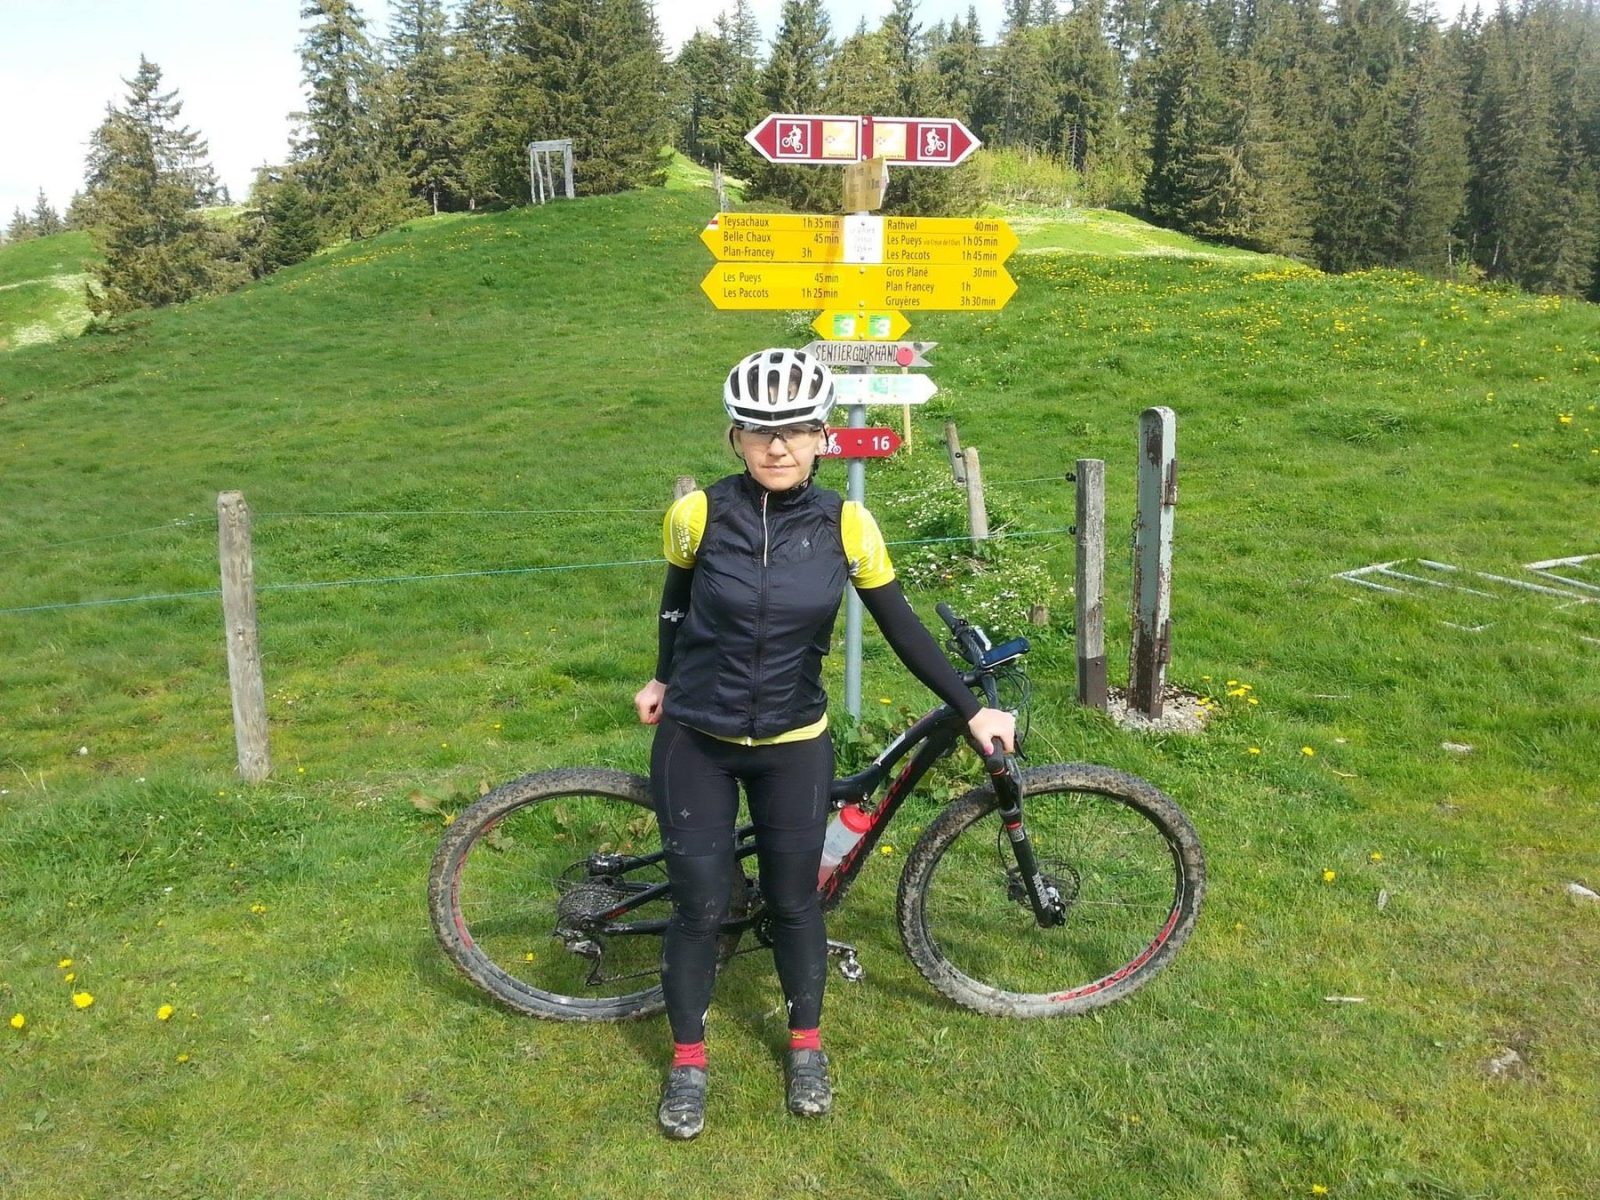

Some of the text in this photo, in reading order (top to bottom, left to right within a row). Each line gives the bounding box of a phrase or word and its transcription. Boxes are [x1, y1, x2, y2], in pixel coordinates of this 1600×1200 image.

[723, 215, 769, 229] Teysachaux
[887, 219, 917, 231] Rathvel
[723, 230, 771, 242] Belle Chaux
[887, 234, 899, 246] Les
[901, 234, 922, 248] Pueys
[723, 245, 775, 260] Plan-Francey
[886, 249, 899, 260] Les
[901, 249, 930, 260] Paccots
[723, 271, 762, 285] Les Pueys
[886, 266, 904, 277] Gros
[723, 287, 769, 298] Les Paccots
[886, 281, 935, 295] Plan Francey
[872, 435, 890, 451] 16
